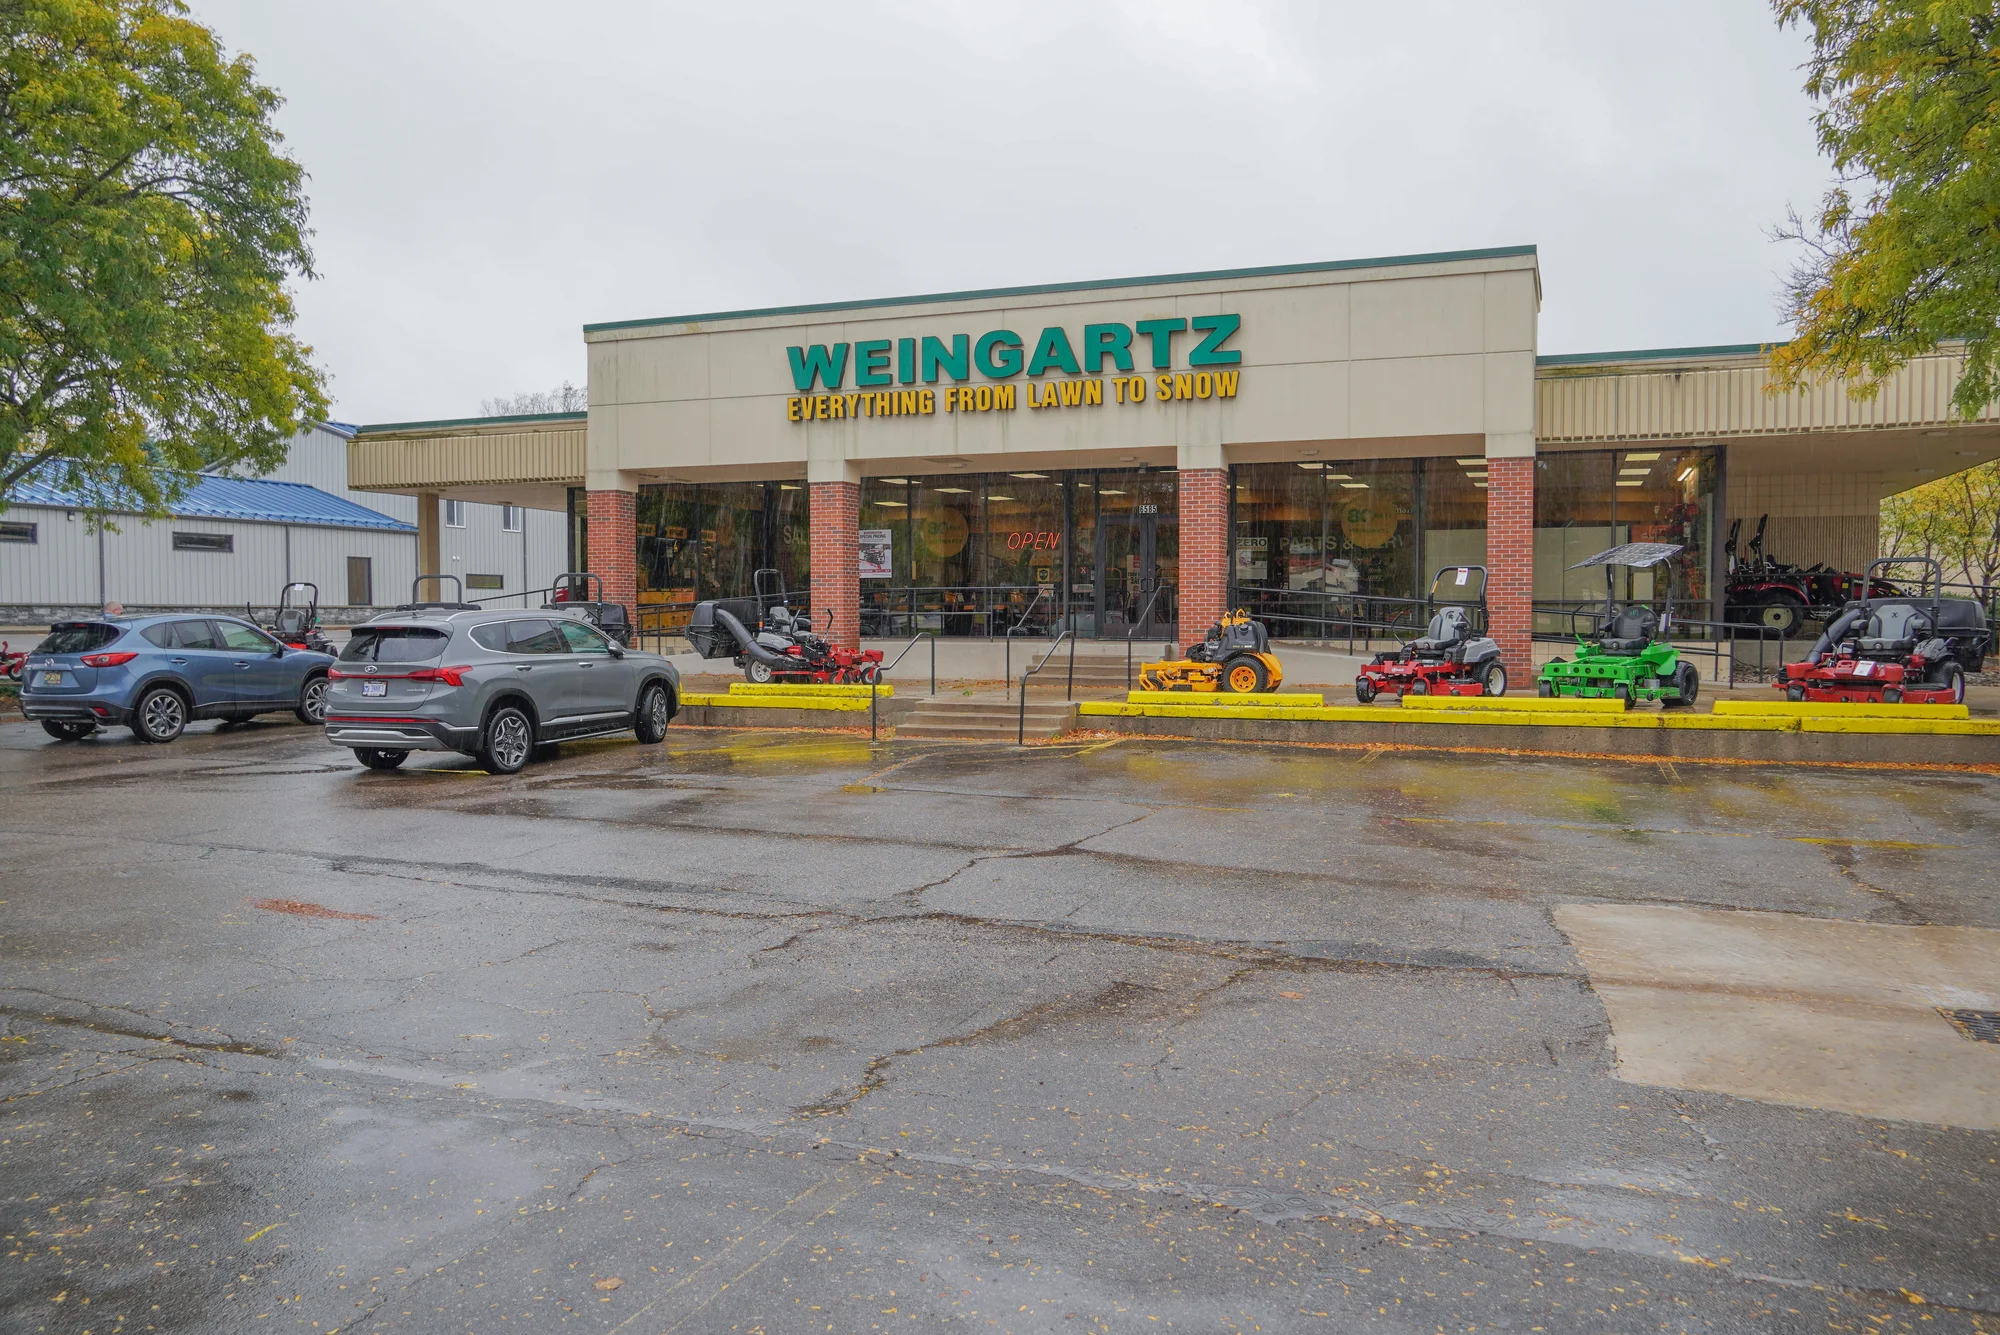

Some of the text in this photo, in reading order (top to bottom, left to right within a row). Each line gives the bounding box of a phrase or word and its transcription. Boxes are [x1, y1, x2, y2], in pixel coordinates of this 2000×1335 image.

[785, 313, 1242, 391] WEINGARTZ
[787, 370, 1240, 422] EVERYTHING FROM LAWN TO SNOW
[783, 524, 810, 545] SAL
[1007, 532, 1061, 550] OPEN
[1236, 538, 1267, 547] ZERO
[1279, 535, 1338, 551] PARTS
